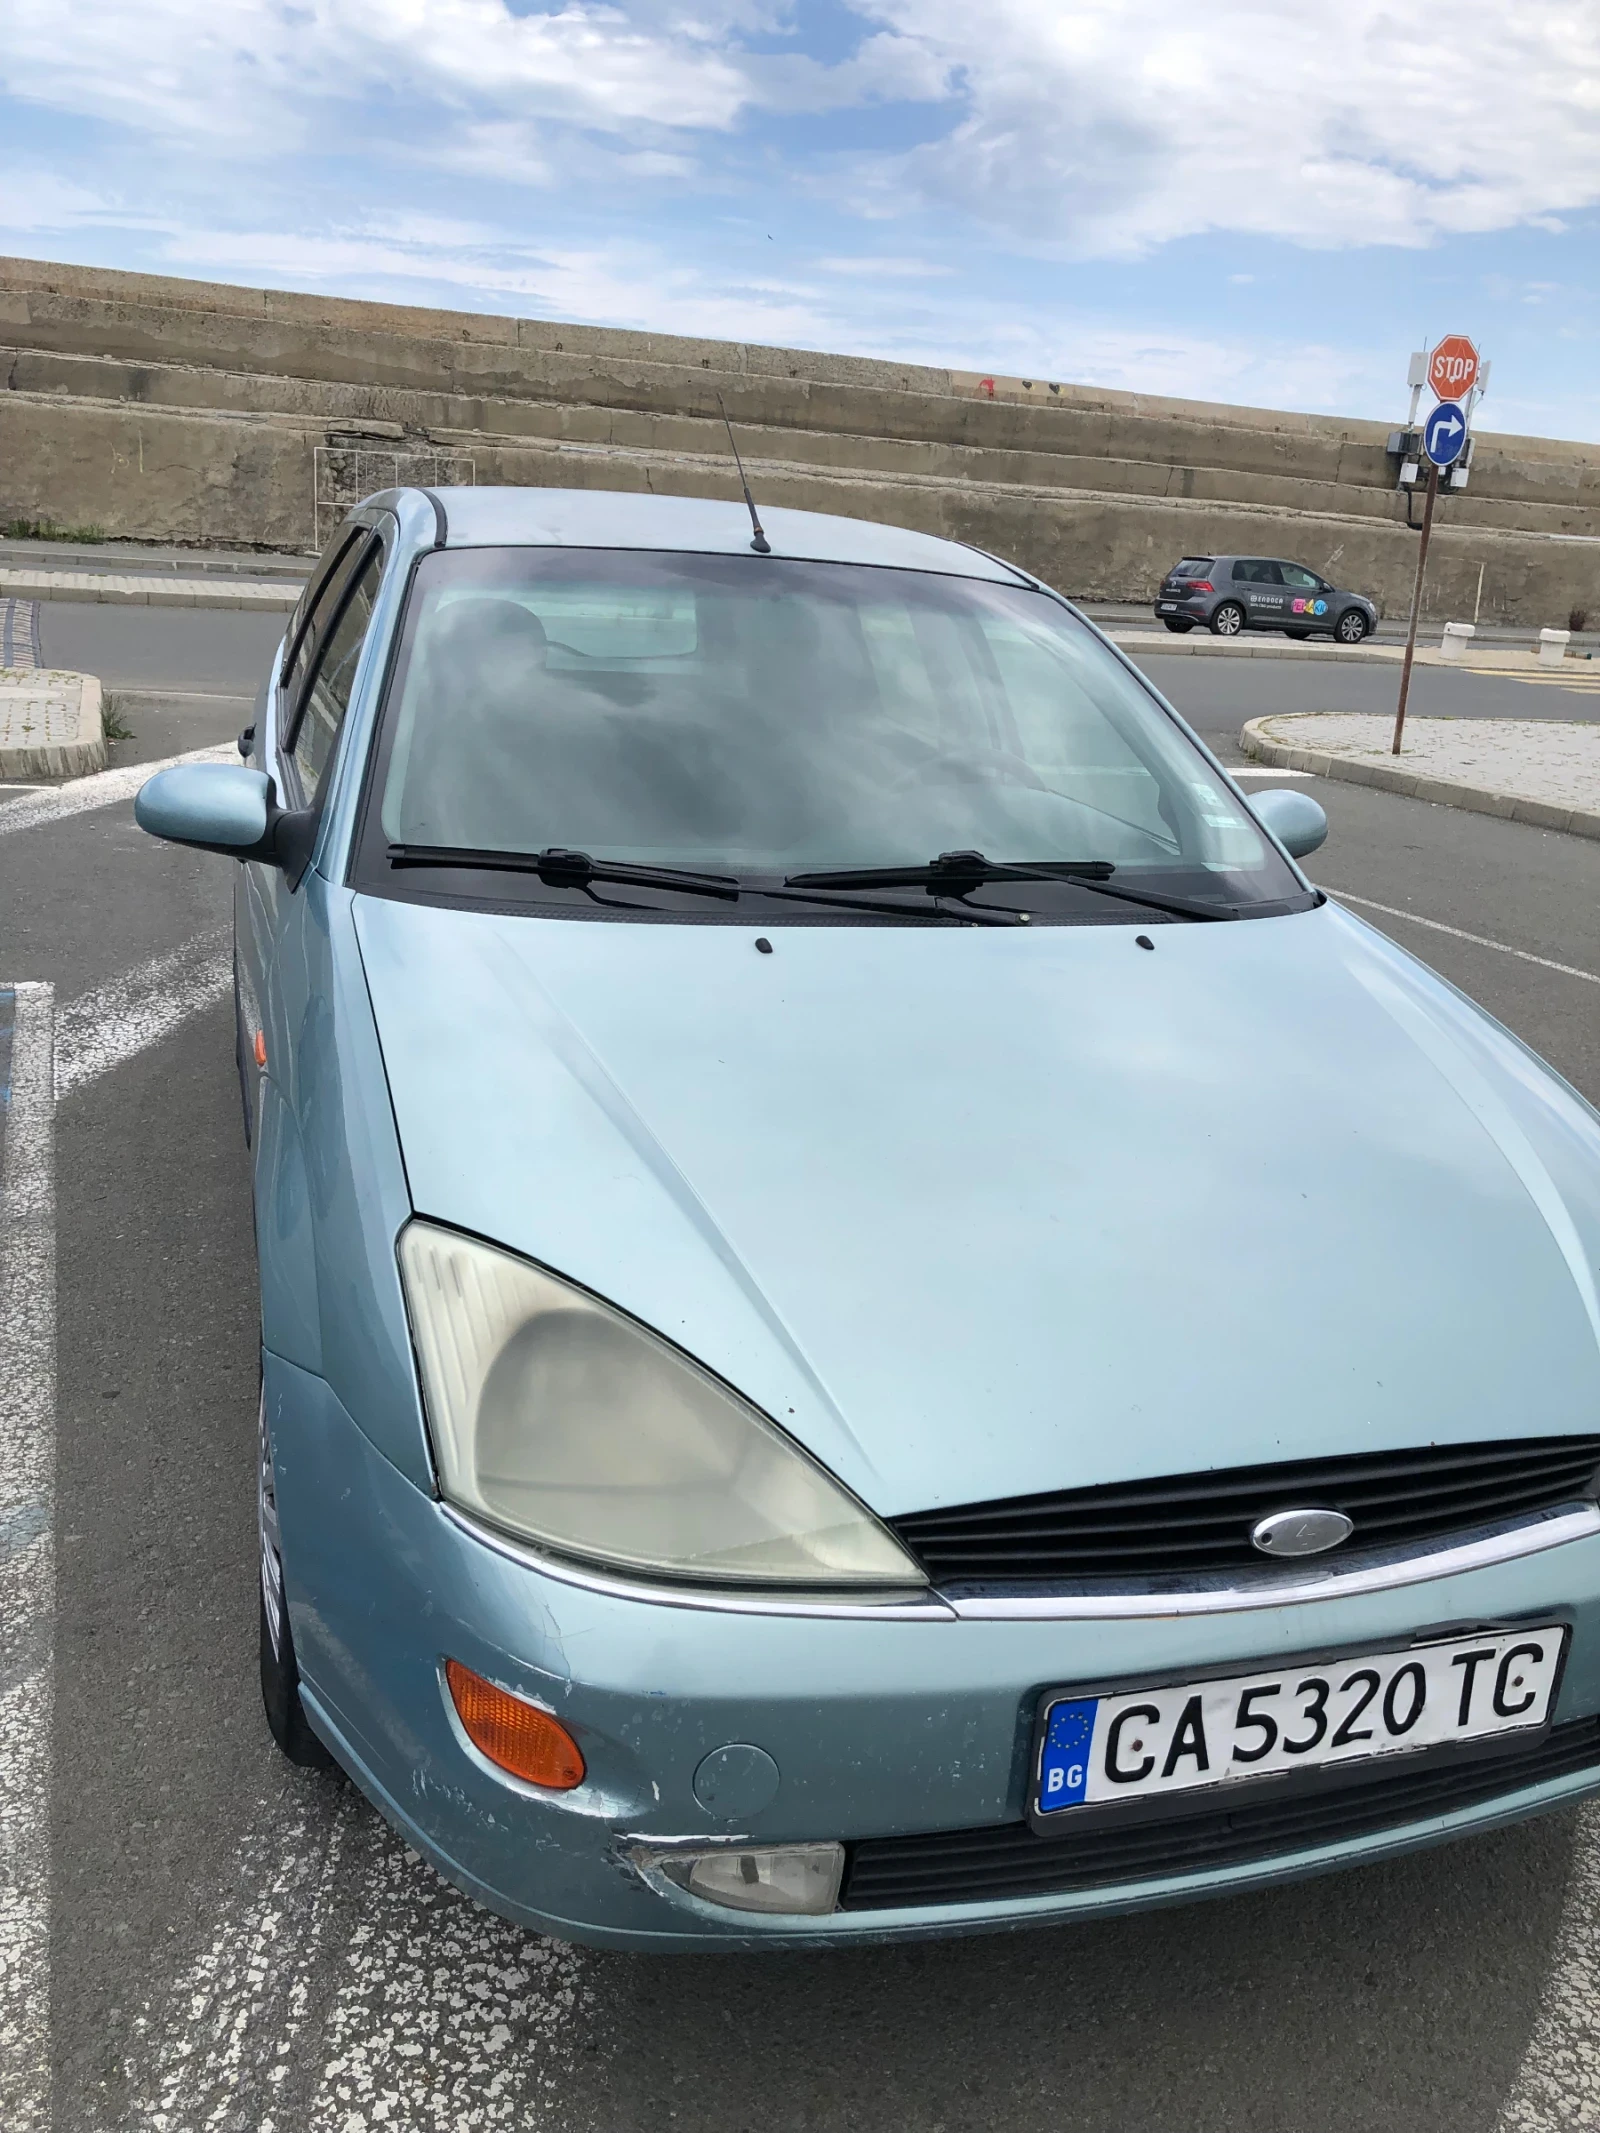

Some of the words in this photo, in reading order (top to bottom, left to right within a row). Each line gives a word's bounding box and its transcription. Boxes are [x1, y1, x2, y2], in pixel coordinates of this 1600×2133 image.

[1434, 356, 1474, 380] STOP
[1104, 1694, 1210, 1783] CA
[1231, 1661, 1427, 1763] 5320
[1451, 1642, 1544, 1727] TC
[1047, 1764, 1083, 1793] BG
